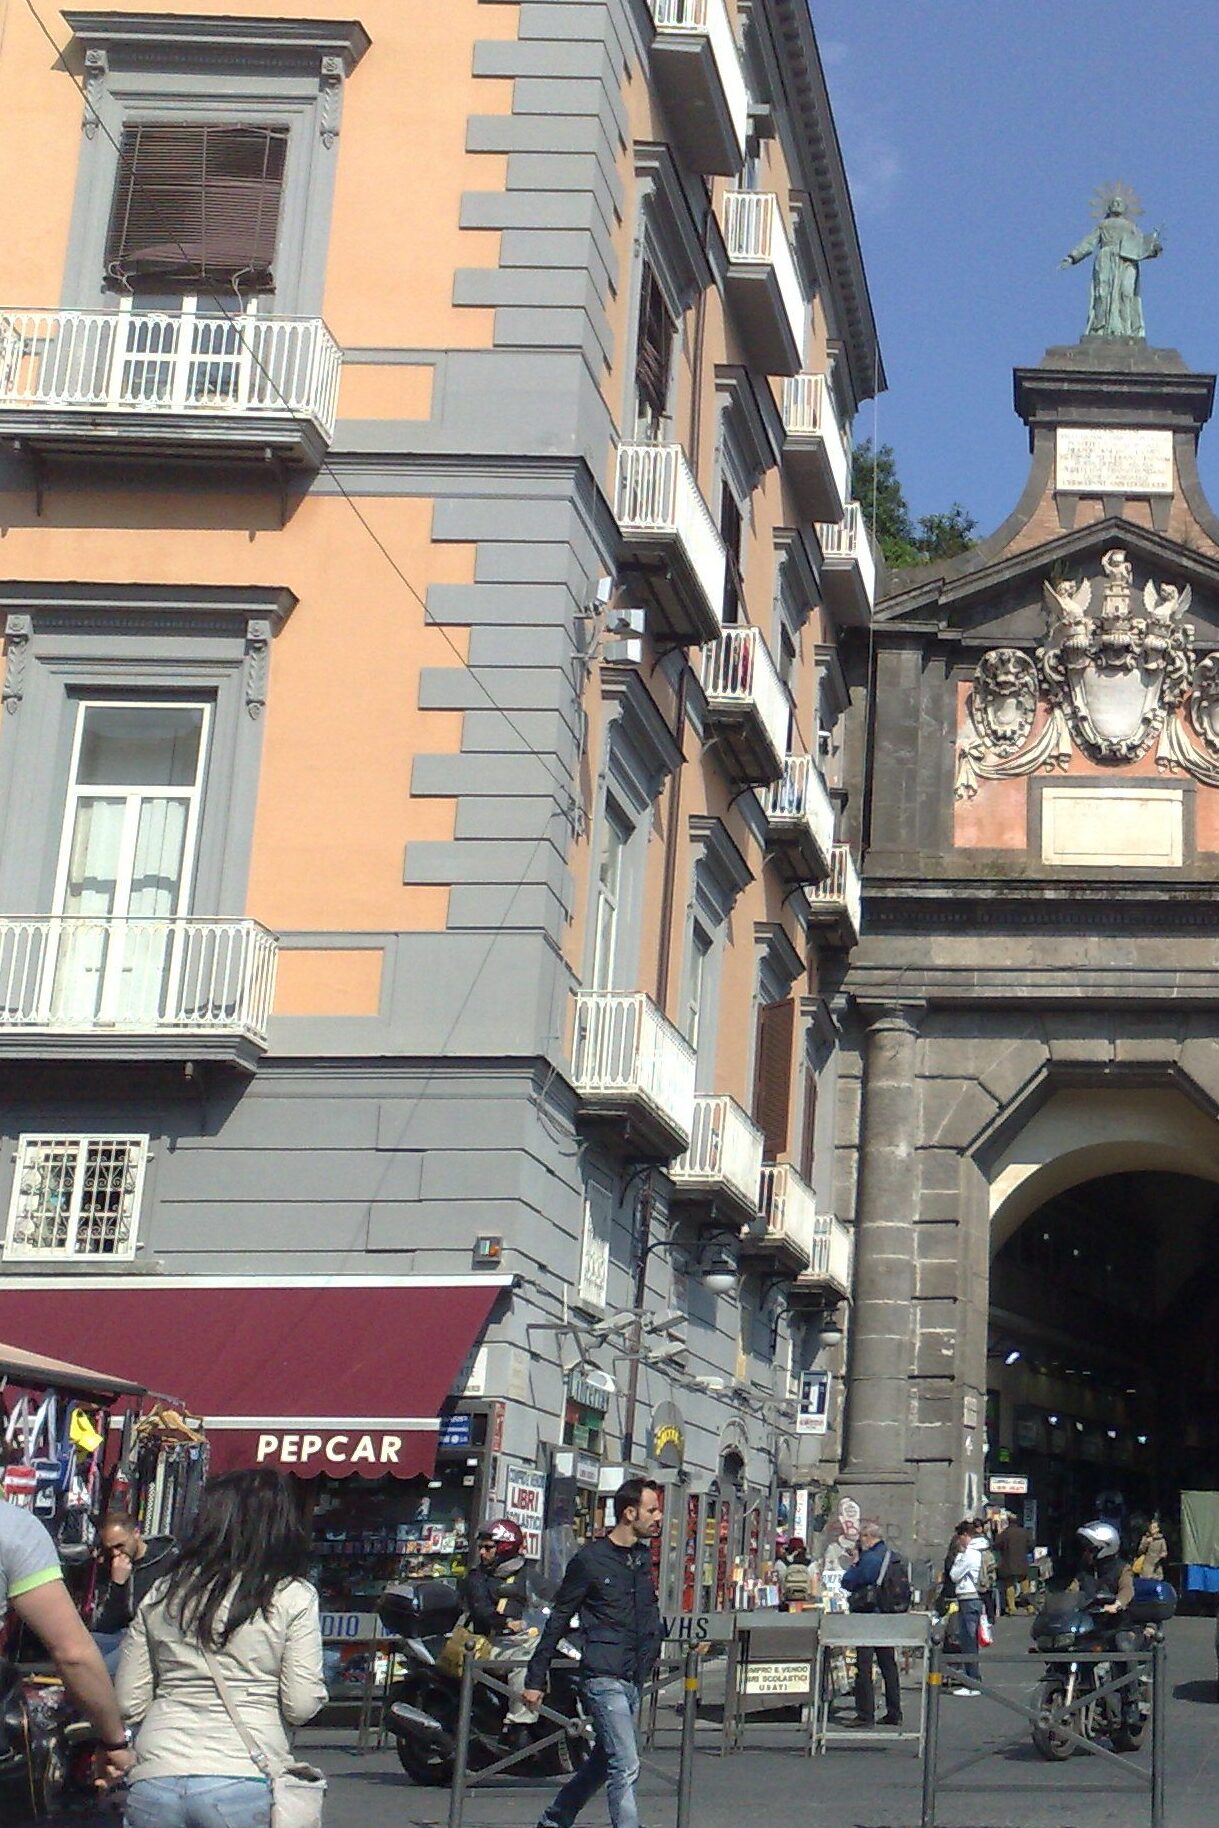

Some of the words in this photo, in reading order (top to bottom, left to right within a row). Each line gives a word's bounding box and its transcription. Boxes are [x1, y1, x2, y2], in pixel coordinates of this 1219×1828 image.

[256, 1434, 402, 1464] PEPCAR
[511, 1487, 540, 1512] LIBRI
[662, 1616, 710, 1640] VHS
